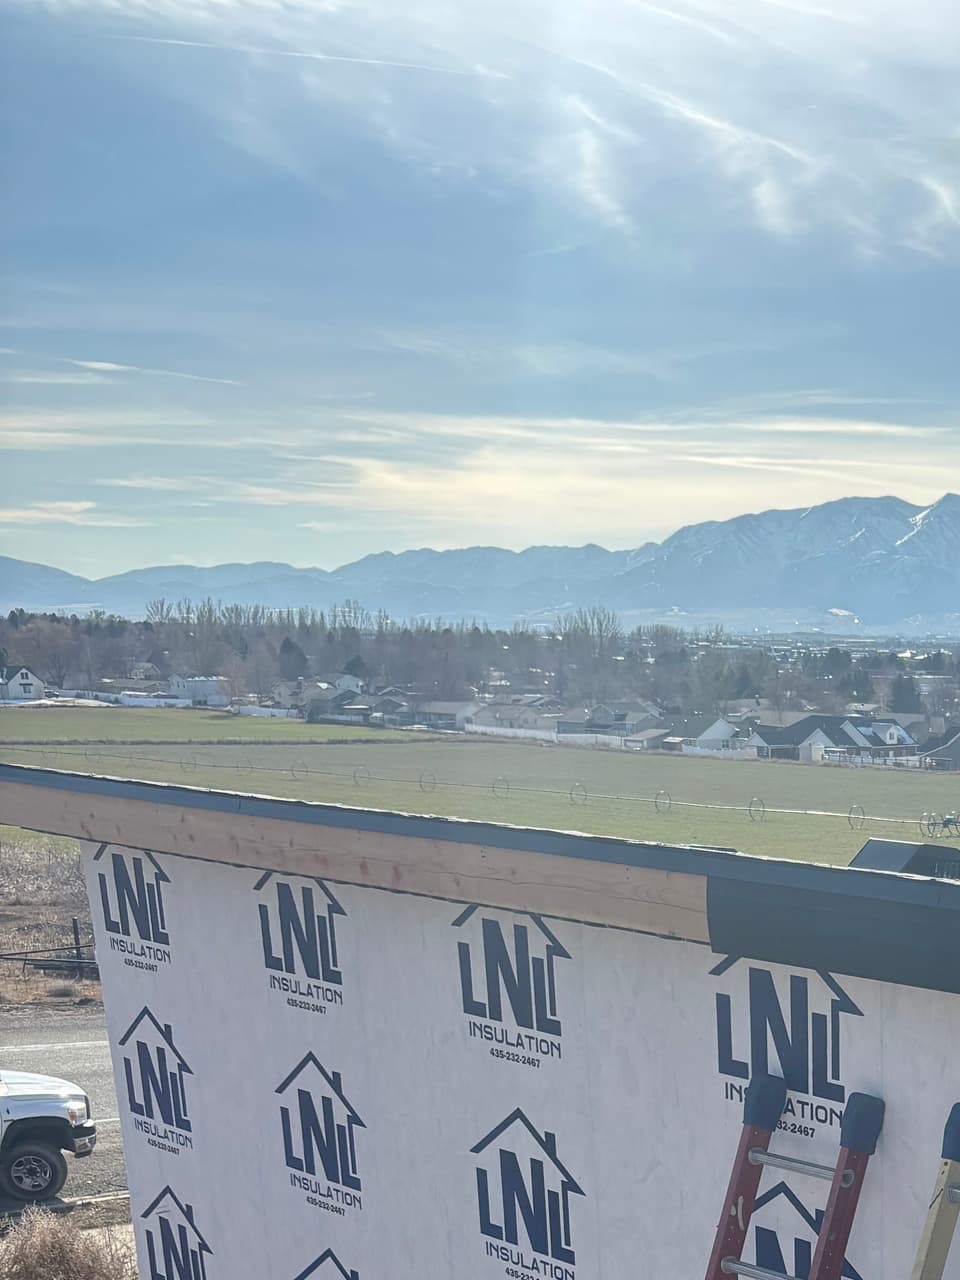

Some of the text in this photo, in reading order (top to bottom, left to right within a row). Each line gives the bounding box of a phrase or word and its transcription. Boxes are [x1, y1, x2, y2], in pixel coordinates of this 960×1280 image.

[110, 937, 171, 964] INSULATION
[269, 974, 343, 1005] INSULATION
[469, 1020, 561, 1058] INSULATION
[489, 1048, 541, 1068] 435-232-2467
[725, 1082, 843, 1126] INATION
[134, 1118, 193, 1149] INSULATION
[777, 1121, 815, 1138] 32-2467
[290, 1173, 362, 1210] INSULATION
